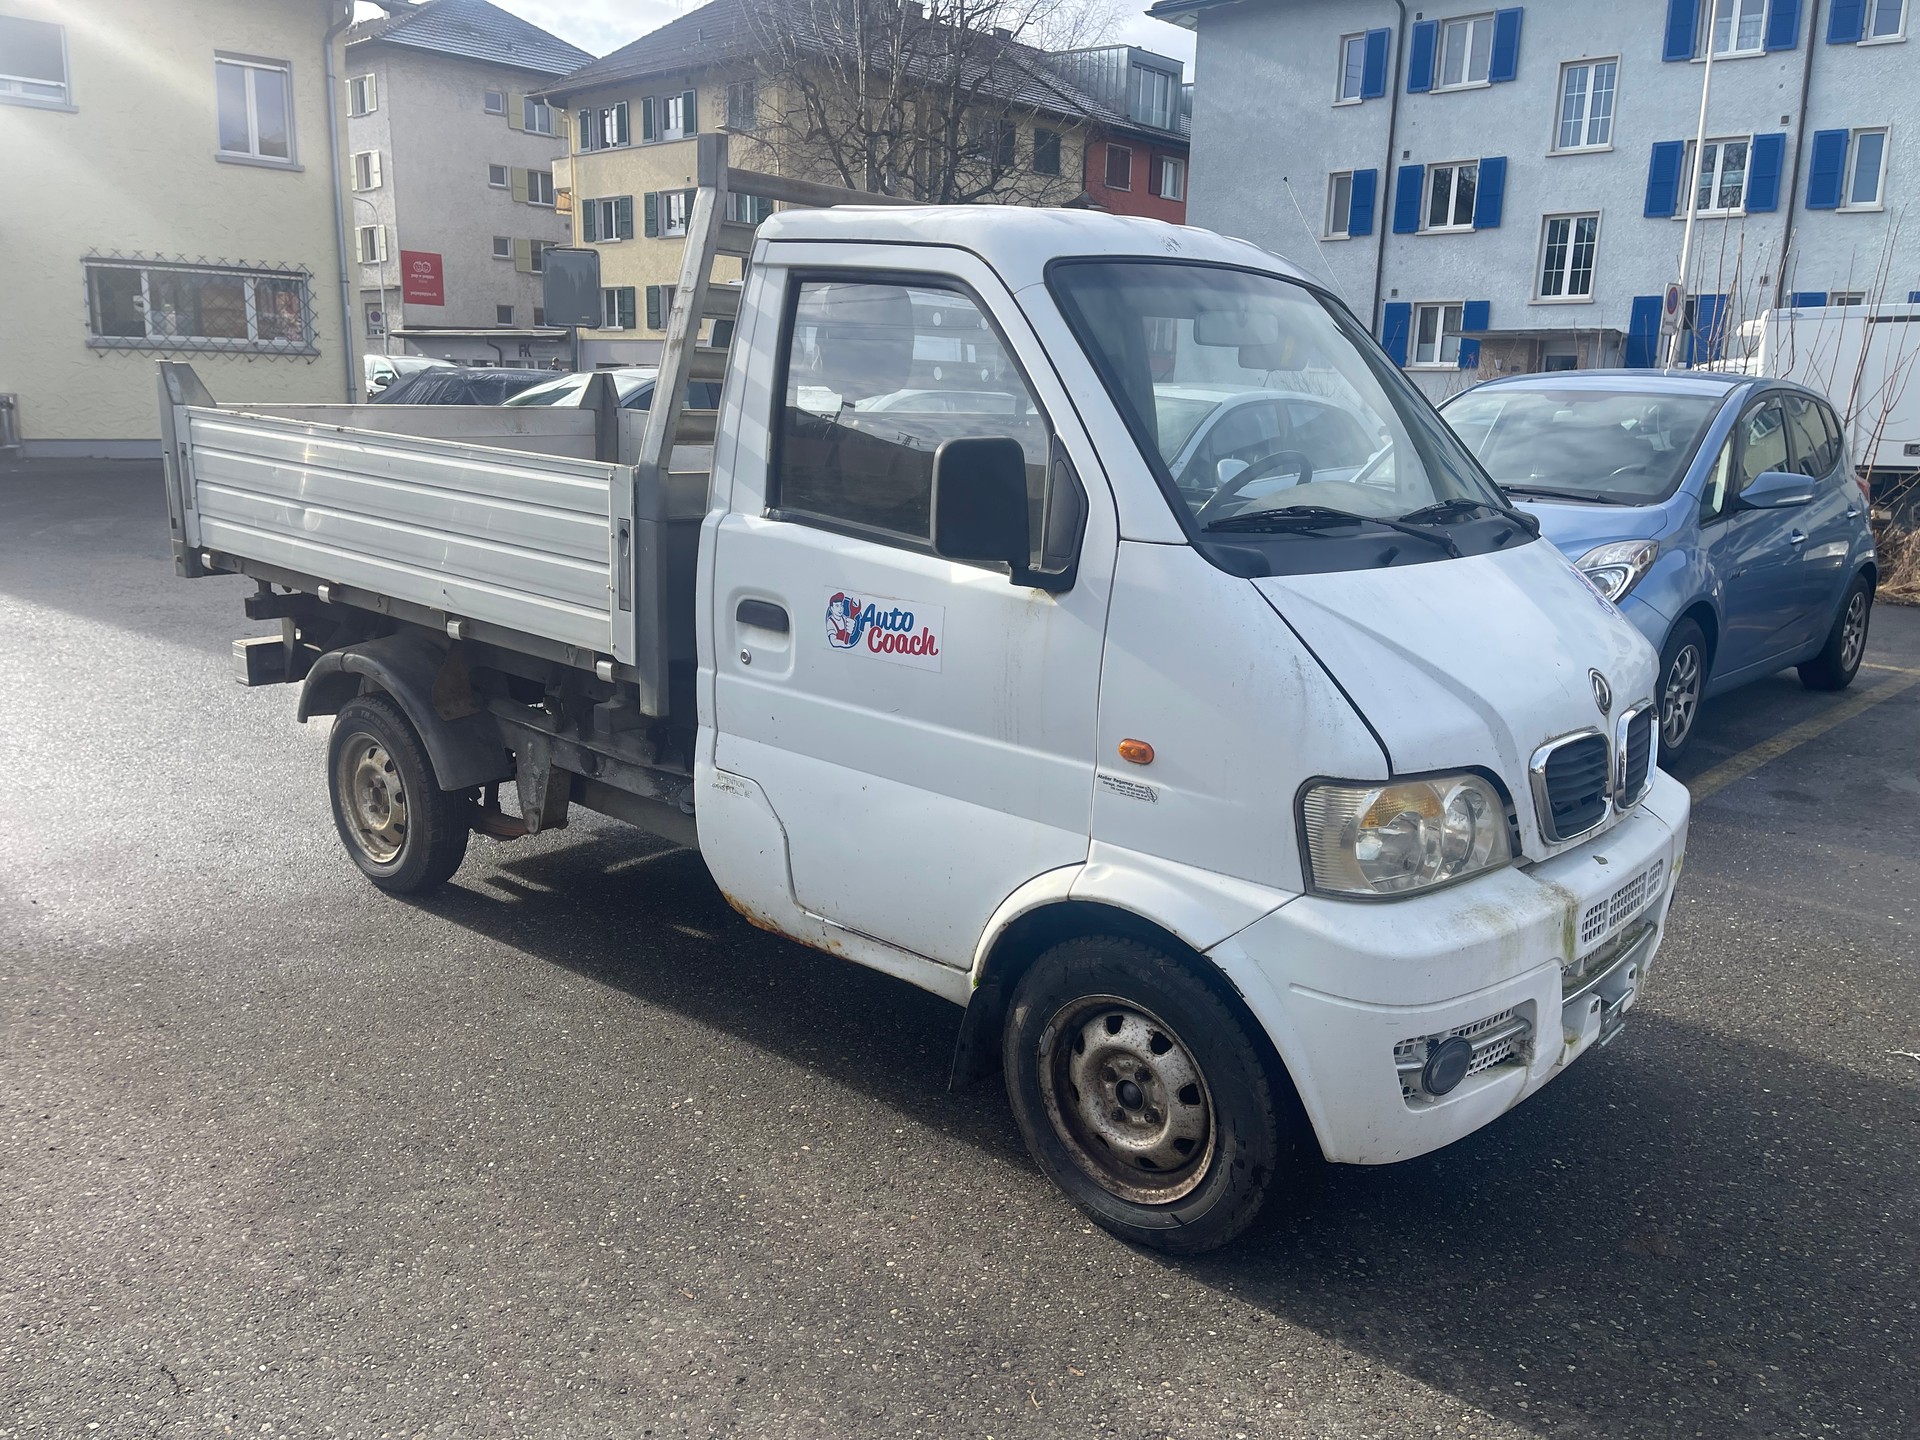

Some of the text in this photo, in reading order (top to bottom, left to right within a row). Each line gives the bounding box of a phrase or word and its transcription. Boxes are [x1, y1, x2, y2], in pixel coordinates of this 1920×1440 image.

[519, 343, 531, 357] FK
[860, 603, 914, 632] Auto
[868, 627, 939, 656] Coach
[717, 775, 745, 789] ATTENTION
